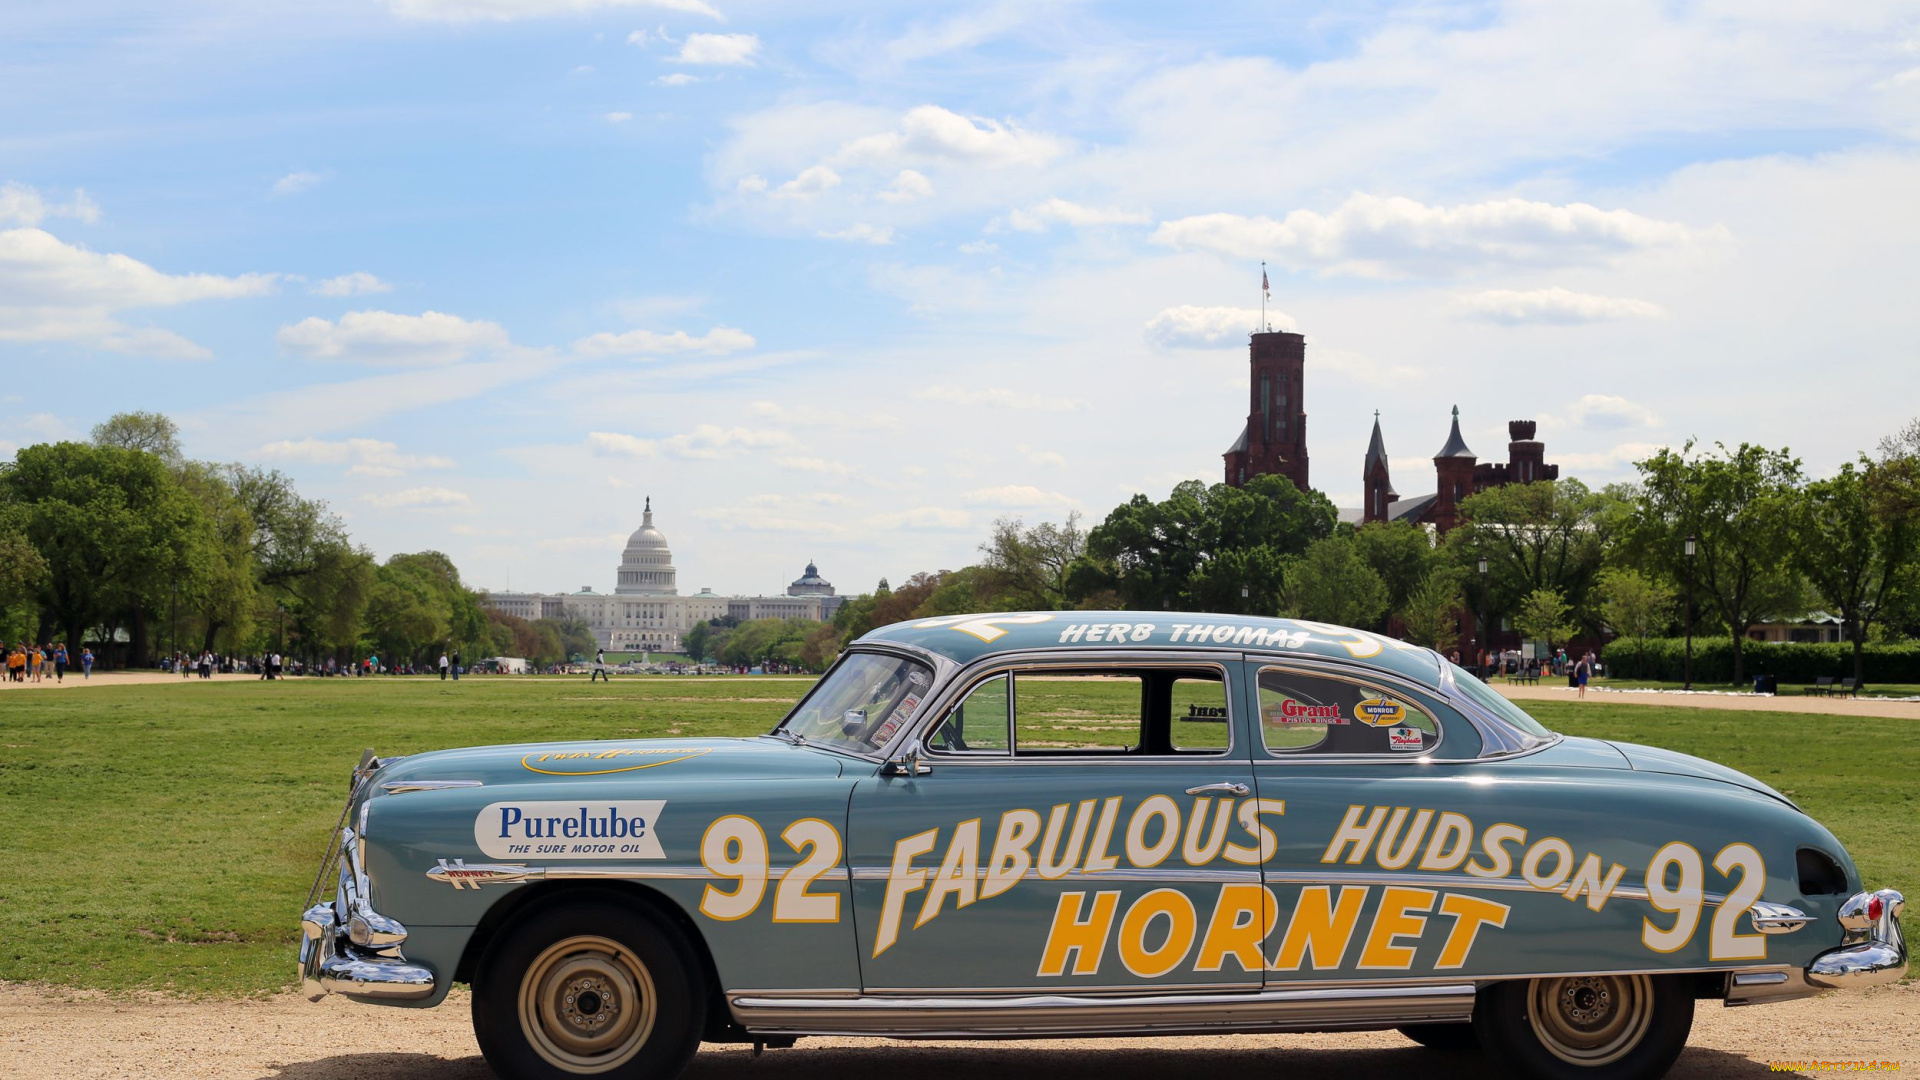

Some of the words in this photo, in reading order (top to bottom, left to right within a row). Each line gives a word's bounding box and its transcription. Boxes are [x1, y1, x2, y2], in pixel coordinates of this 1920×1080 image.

[1058, 623, 1156, 644] HERB
[1168, 623, 1311, 649] THOMAS
[1281, 698, 1341, 718] Grant
[498, 807, 646, 839] Purelube
[507, 844, 534, 853] THE
[537, 844, 567, 853] SURE
[571, 844, 616, 853] MOTOR
[620, 844, 640, 853] OIL
[447, 870, 493, 878] HORNET
[698, 814, 843, 923] 92
[872, 794, 1286, 959] FABULOUS
[1321, 804, 1627, 912] HUDSON
[1641, 841, 1768, 961] 92
[1036, 883, 1511, 978] HORNET
